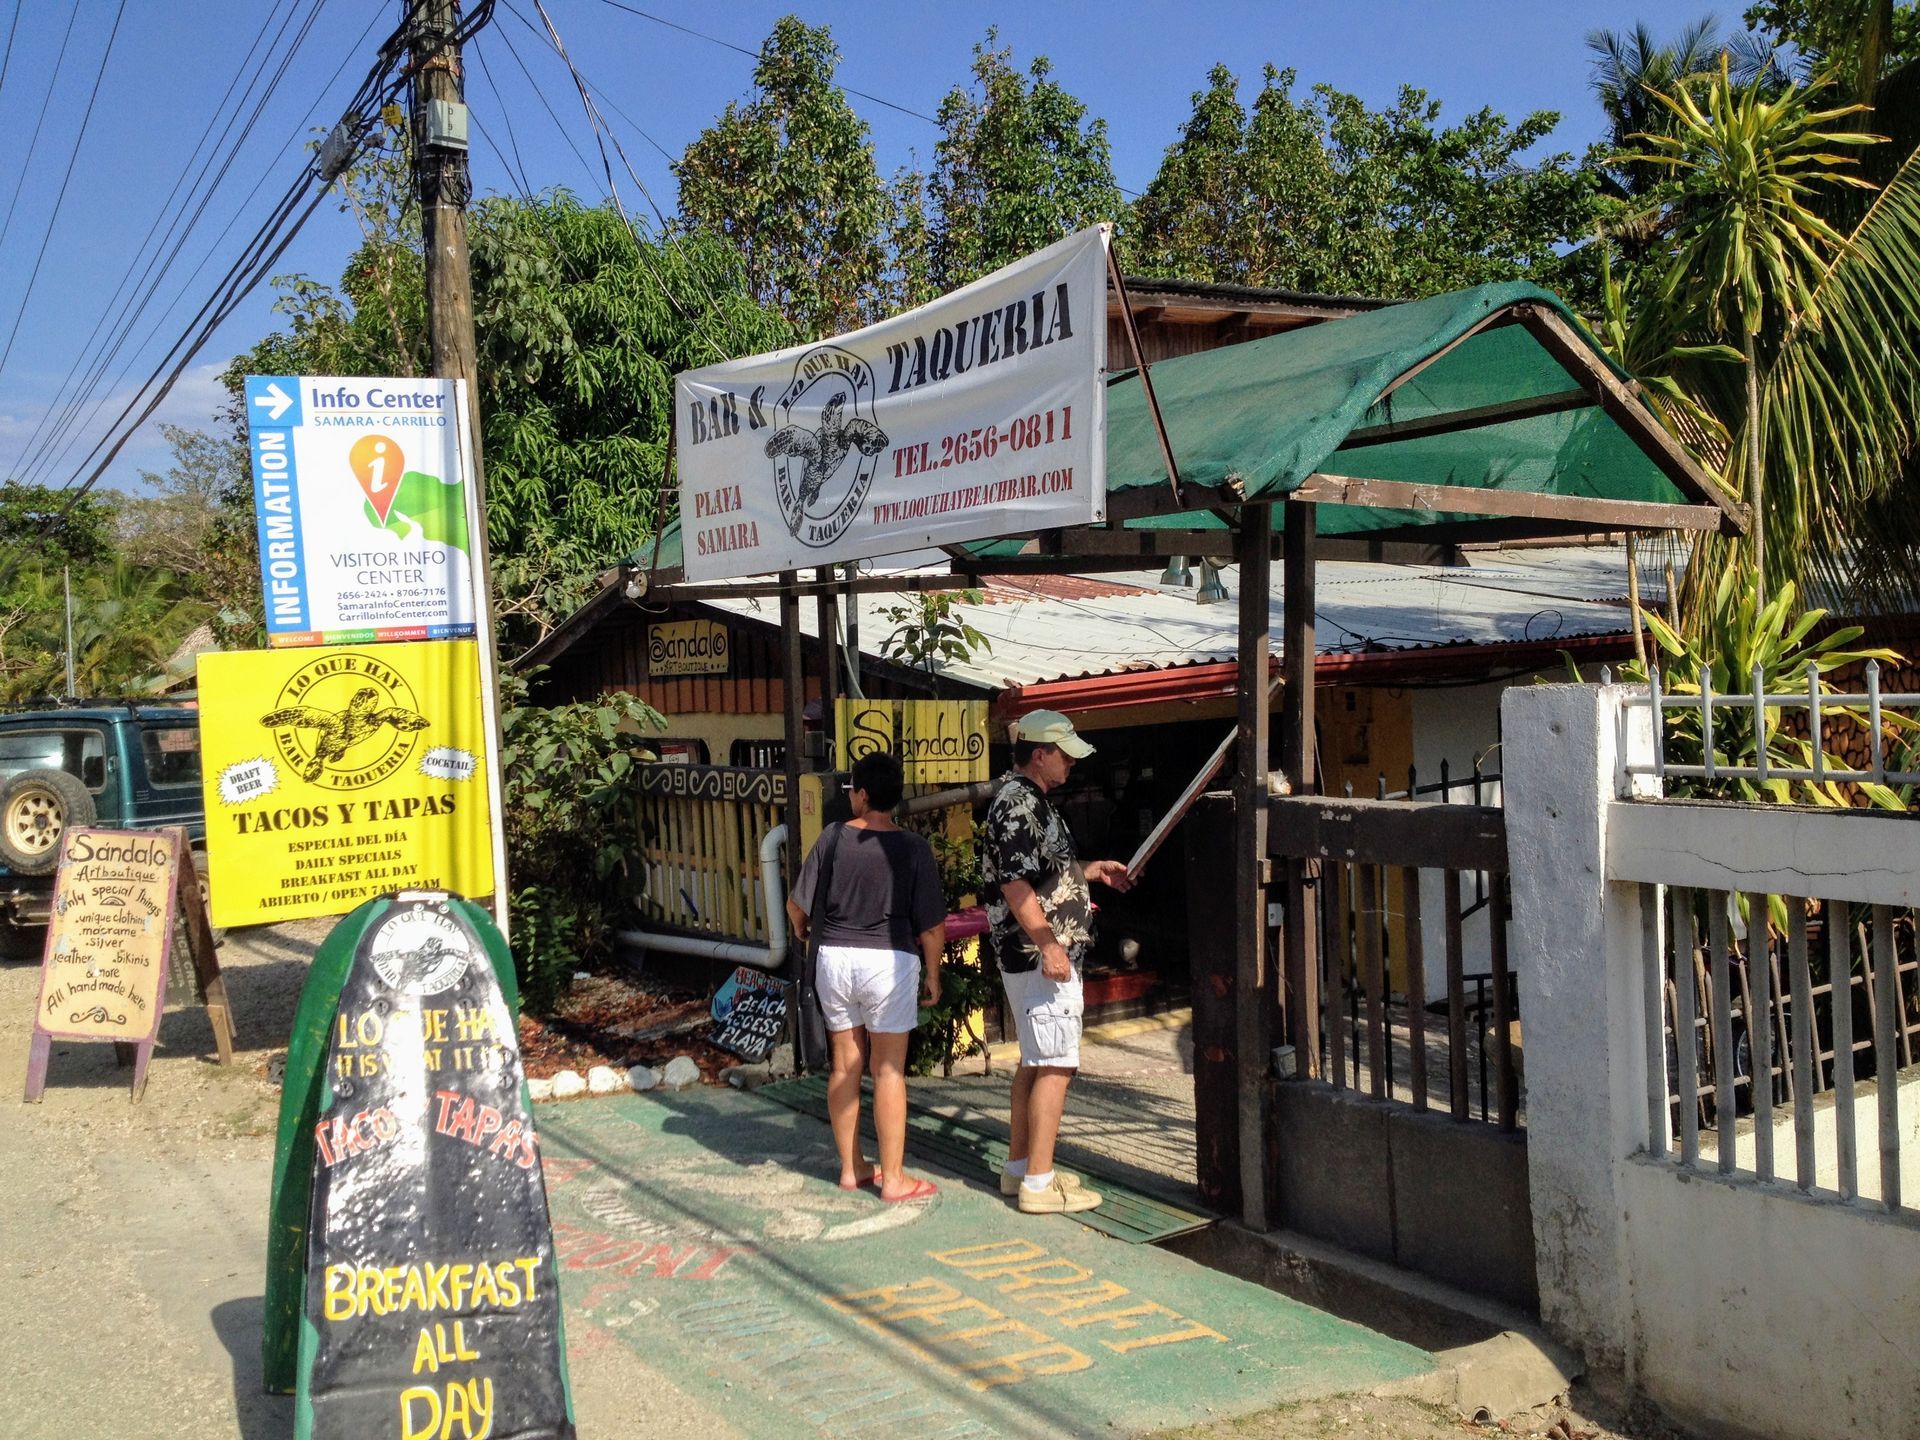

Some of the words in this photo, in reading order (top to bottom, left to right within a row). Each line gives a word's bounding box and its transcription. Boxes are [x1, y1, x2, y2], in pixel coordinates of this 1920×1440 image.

[690, 389, 741, 447] BAR
[749, 385, 769, 430] &
[886, 283, 1074, 394] TAQUERIA
[780, 379, 804, 410] LO
[802, 353, 833, 380] QUE
[834, 354, 870, 392] HAY
[312, 387, 360, 408] Info
[366, 388, 446, 408] Center
[314, 416, 374, 427] SAMARA
[382, 416, 447, 427] CARRILLO
[694, 484, 743, 519] PLAYA
[777, 466, 791, 512] BAR
[873, 467, 1073, 525] WWW.LOQUEHAYBEACHBAR.COM
[808, 472, 870, 542] TAQUERIA
[259, 431, 302, 625] INFORMATION
[696, 520, 760, 556] SAMARA
[330, 552, 399, 568] VISITOR
[404, 550, 446, 565] INFO
[357, 569, 424, 585] CENTER
[337, 590, 387, 600] 2656-2424
[396, 587, 446, 597] 8706-7176
[337, 599, 447, 611] SamaraInfoCenter.com
[338, 609, 448, 622] CarrilloInfoCenter.com
[433, 626, 472, 635] BIENVENUE
[278, 635, 315, 643] WELCOME
[325, 632, 375, 642] BIENVENIDOS
[650, 621, 726, 662] Sándalo
[287, 674, 311, 698] LO
[314, 658, 357, 676] QUE
[364, 661, 403, 691] HAY
[279, 733, 304, 767] BAR
[331, 742, 410, 787] TAQUERIA
[426, 756, 470, 771] COCKTAIL
[229, 767, 261, 785] DRAFT
[236, 778, 263, 795] BEER
[232, 804, 329, 834] TACOS
[336, 802, 357, 825] Y
[364, 793, 456, 820] TAPAS
[66, 834, 167, 867] Sándalo
[288, 836, 353, 853] ESPECIAL
[356, 834, 381, 845] DEL
[385, 830, 407, 842] DÍA
[295, 856, 335, 870] DAILY
[338, 850, 402, 866] SPECIALS
[280, 871, 361, 889] BREAKFAST
[365, 867, 389, 880] ALL
[392, 864, 418, 876] DAY
[92, 885, 135, 899] special
[259, 892, 320, 909] ABIERTO
[331, 886, 368, 900] OPEN
[47, 988, 65, 1015] All
[128, 984, 147, 1011] here
[736, 995, 787, 1016] BEACH
[338, 1012, 384, 1048] LO
[723, 1011, 781, 1037] ACCESS
[717, 1026, 767, 1056] PLAYA
[336, 1054, 354, 1077] IT
[359, 1053, 379, 1077] IS
[454, 1047, 474, 1070] IT
[435, 1089, 541, 1169] TAPAS
[324, 1256, 542, 1321] BREAKFAST
[925, 1236, 1230, 1354] DRAFT
[412, 1320, 480, 1375] ALL
[821, 1276, 1097, 1391] BEER
[400, 1376, 494, 1440] DAY
